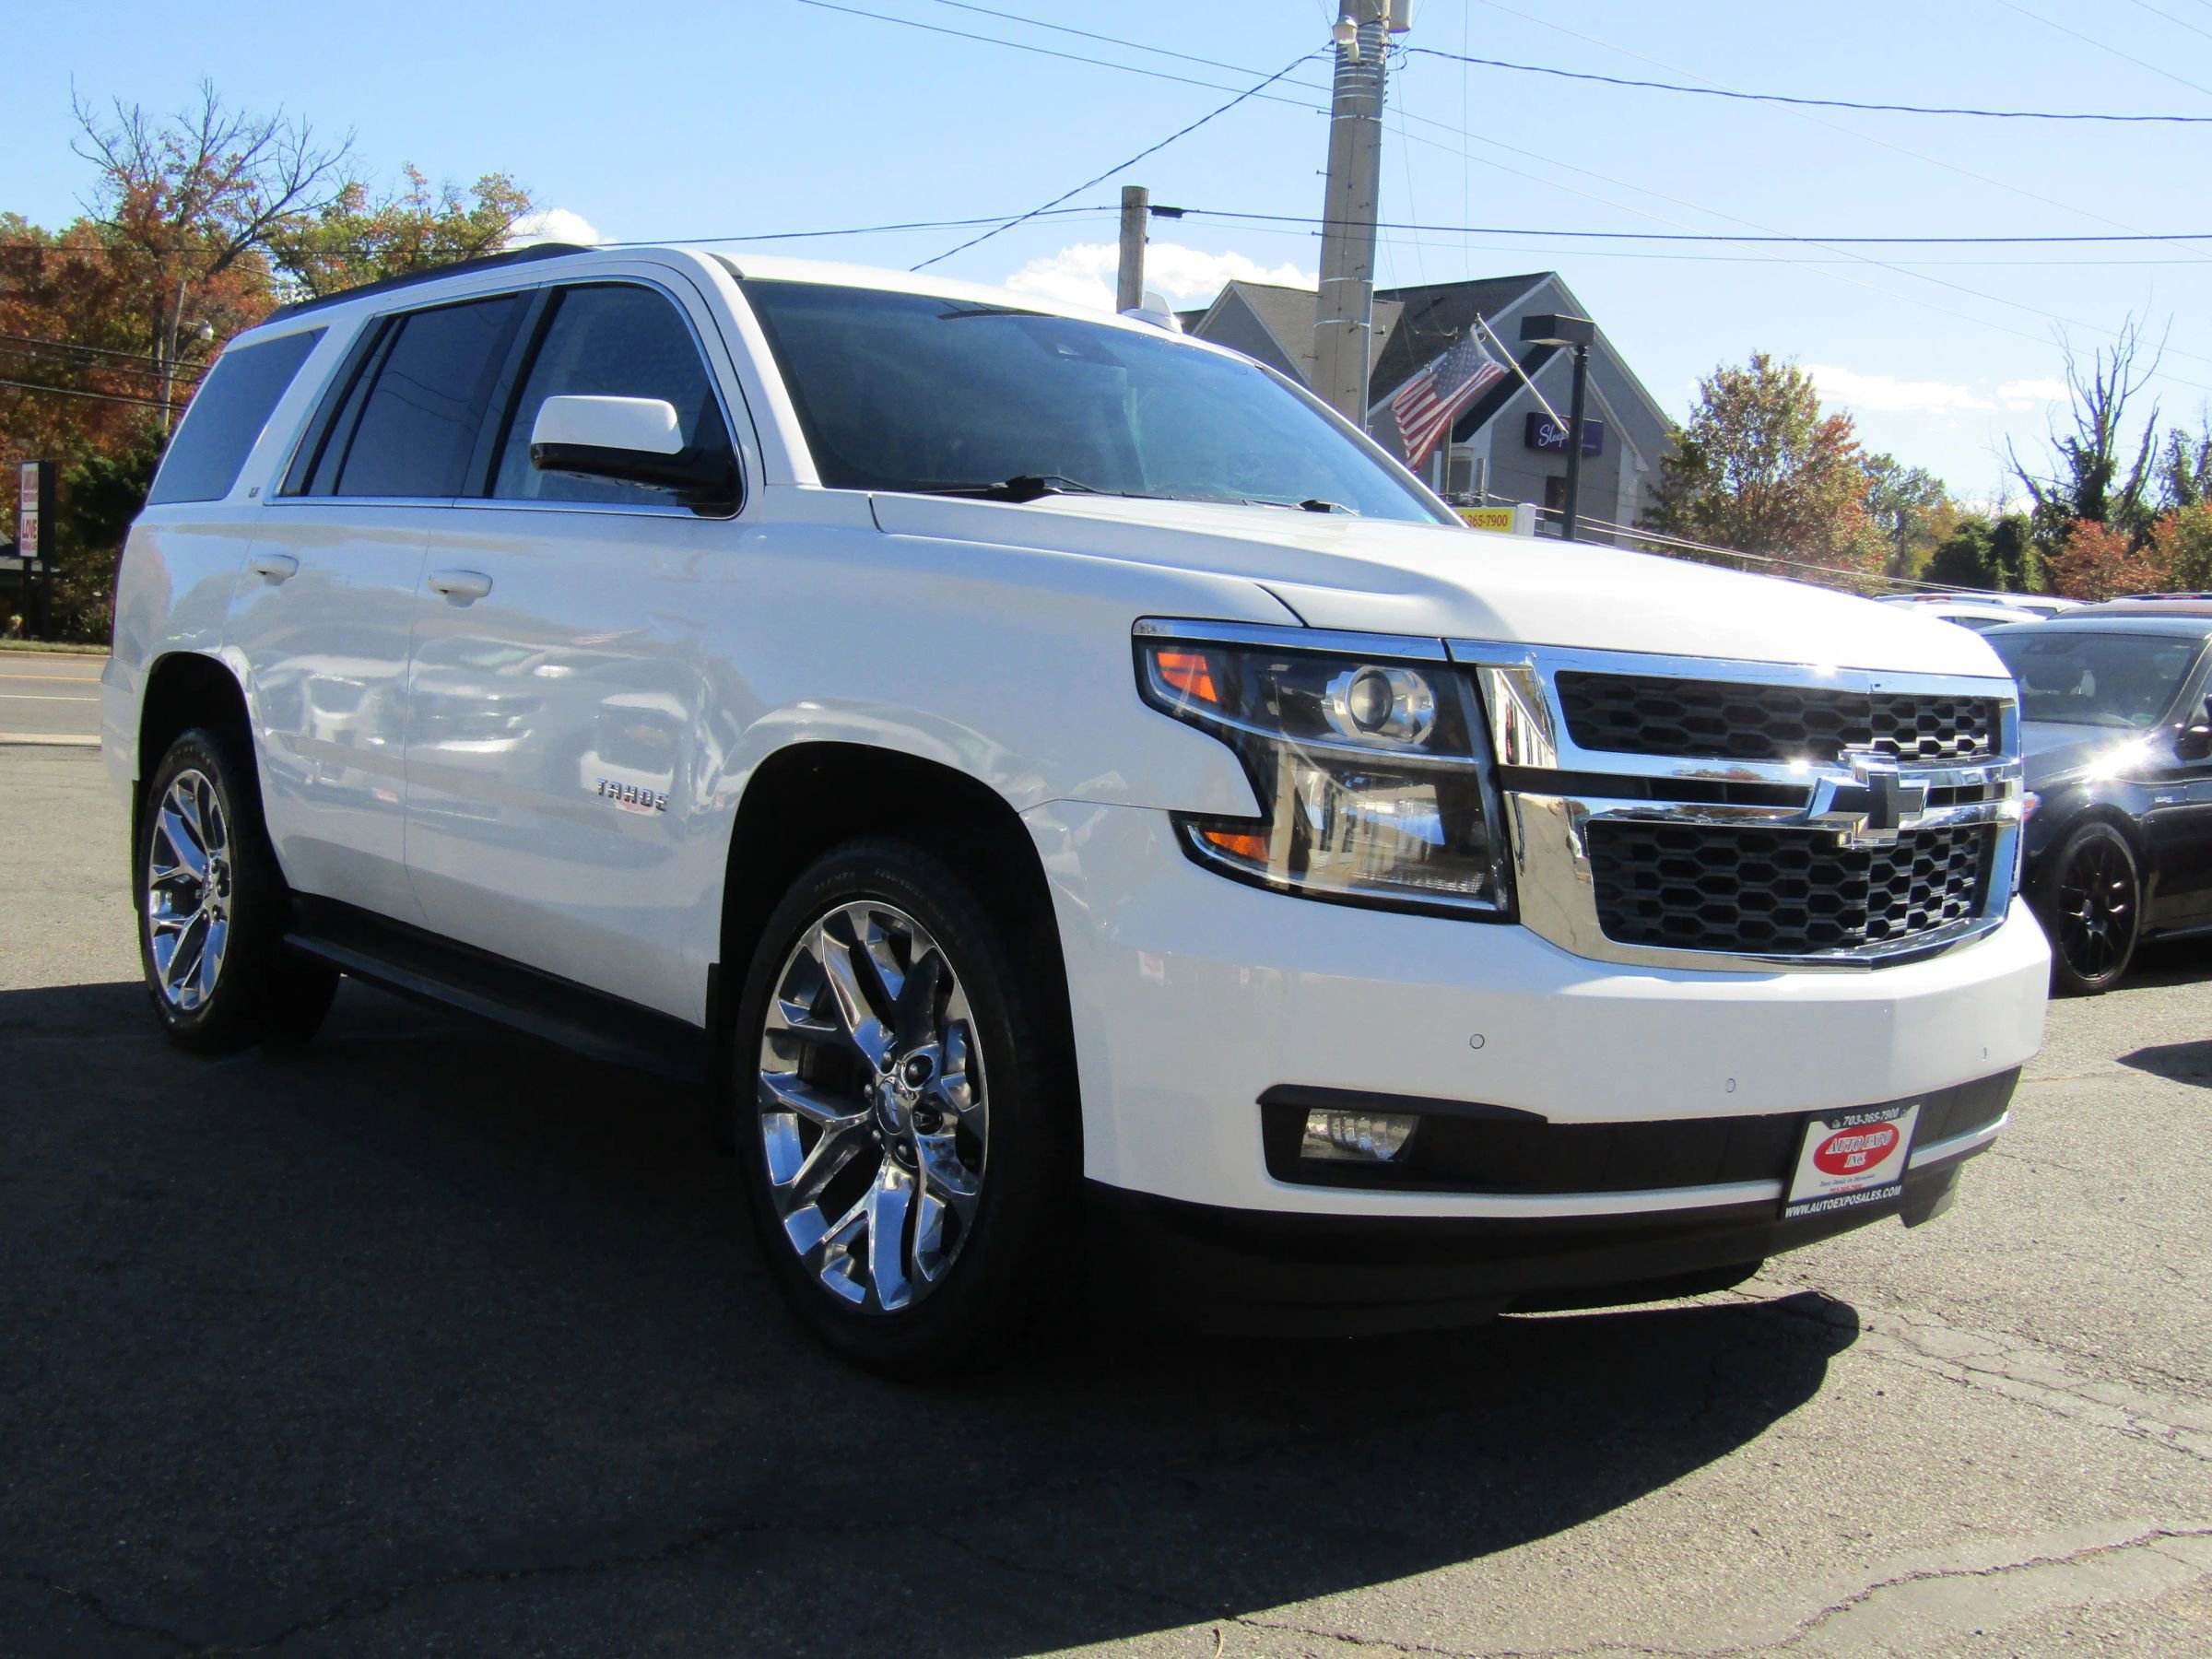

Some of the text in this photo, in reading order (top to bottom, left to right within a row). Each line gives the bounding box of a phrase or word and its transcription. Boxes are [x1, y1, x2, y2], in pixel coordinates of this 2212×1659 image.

[596, 777, 669, 811] TAHOE
[1842, 1107, 1900, 1125] 703-365-7900
[1826, 1130, 1893, 1155] AUTO EXPO
[1784, 1185, 1902, 1218] WWW.AUTOEXPOSALES.COM
